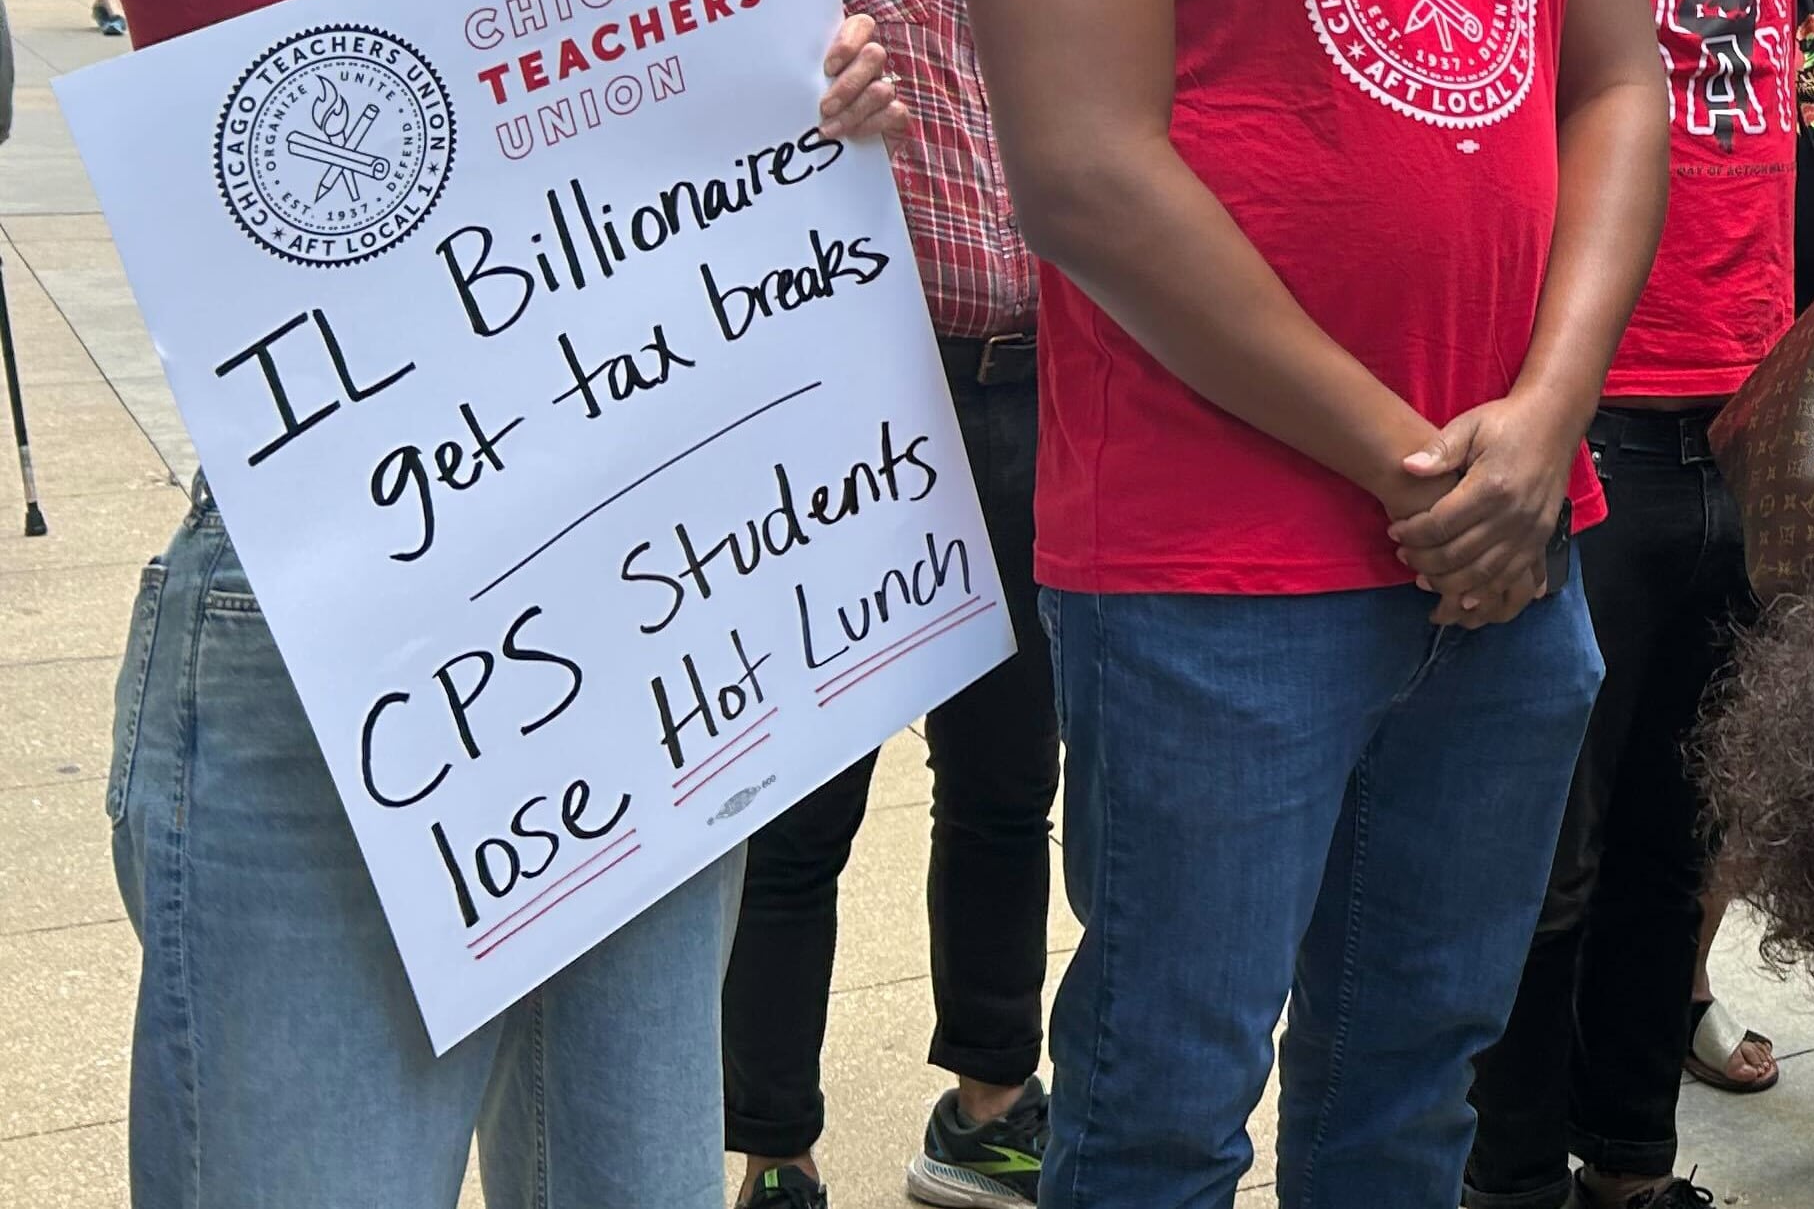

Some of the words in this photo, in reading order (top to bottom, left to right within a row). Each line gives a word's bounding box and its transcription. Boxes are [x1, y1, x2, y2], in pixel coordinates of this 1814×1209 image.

[495, 54, 687, 161] UNION
[1362, 59, 1423, 102] AFT
[1431, 80, 1513, 114] LOCAL
[1508, 63, 1524, 85] 1
[1415, 48, 1461, 72] 1937
[227, 94, 269, 226] CHICAGO
[255, 35, 401, 87] TEACHERS
[406, 63, 446, 151] UNION
[263, 84, 308, 172] ORGANIZE
[340, 71, 396, 102] UNITE
[385, 122, 414, 193] DEFEND
[287, 234, 337, 257] AFT
[346, 204, 421, 254] LOCAL
[417, 184, 433, 198] 1
[326, 203, 369, 222] 1937
[214, 307, 417, 467] IL
[435, 125, 844, 338] Billionaires
[370, 401, 527, 562] get
[552, 323, 697, 419] tax
[699, 228, 890, 341] breaks
[360, 604, 584, 809] CPS
[619, 419, 939, 635] Students
[430, 779, 632, 929] lose
[650, 628, 773, 770] Hot
[796, 531, 973, 671] Lunch
